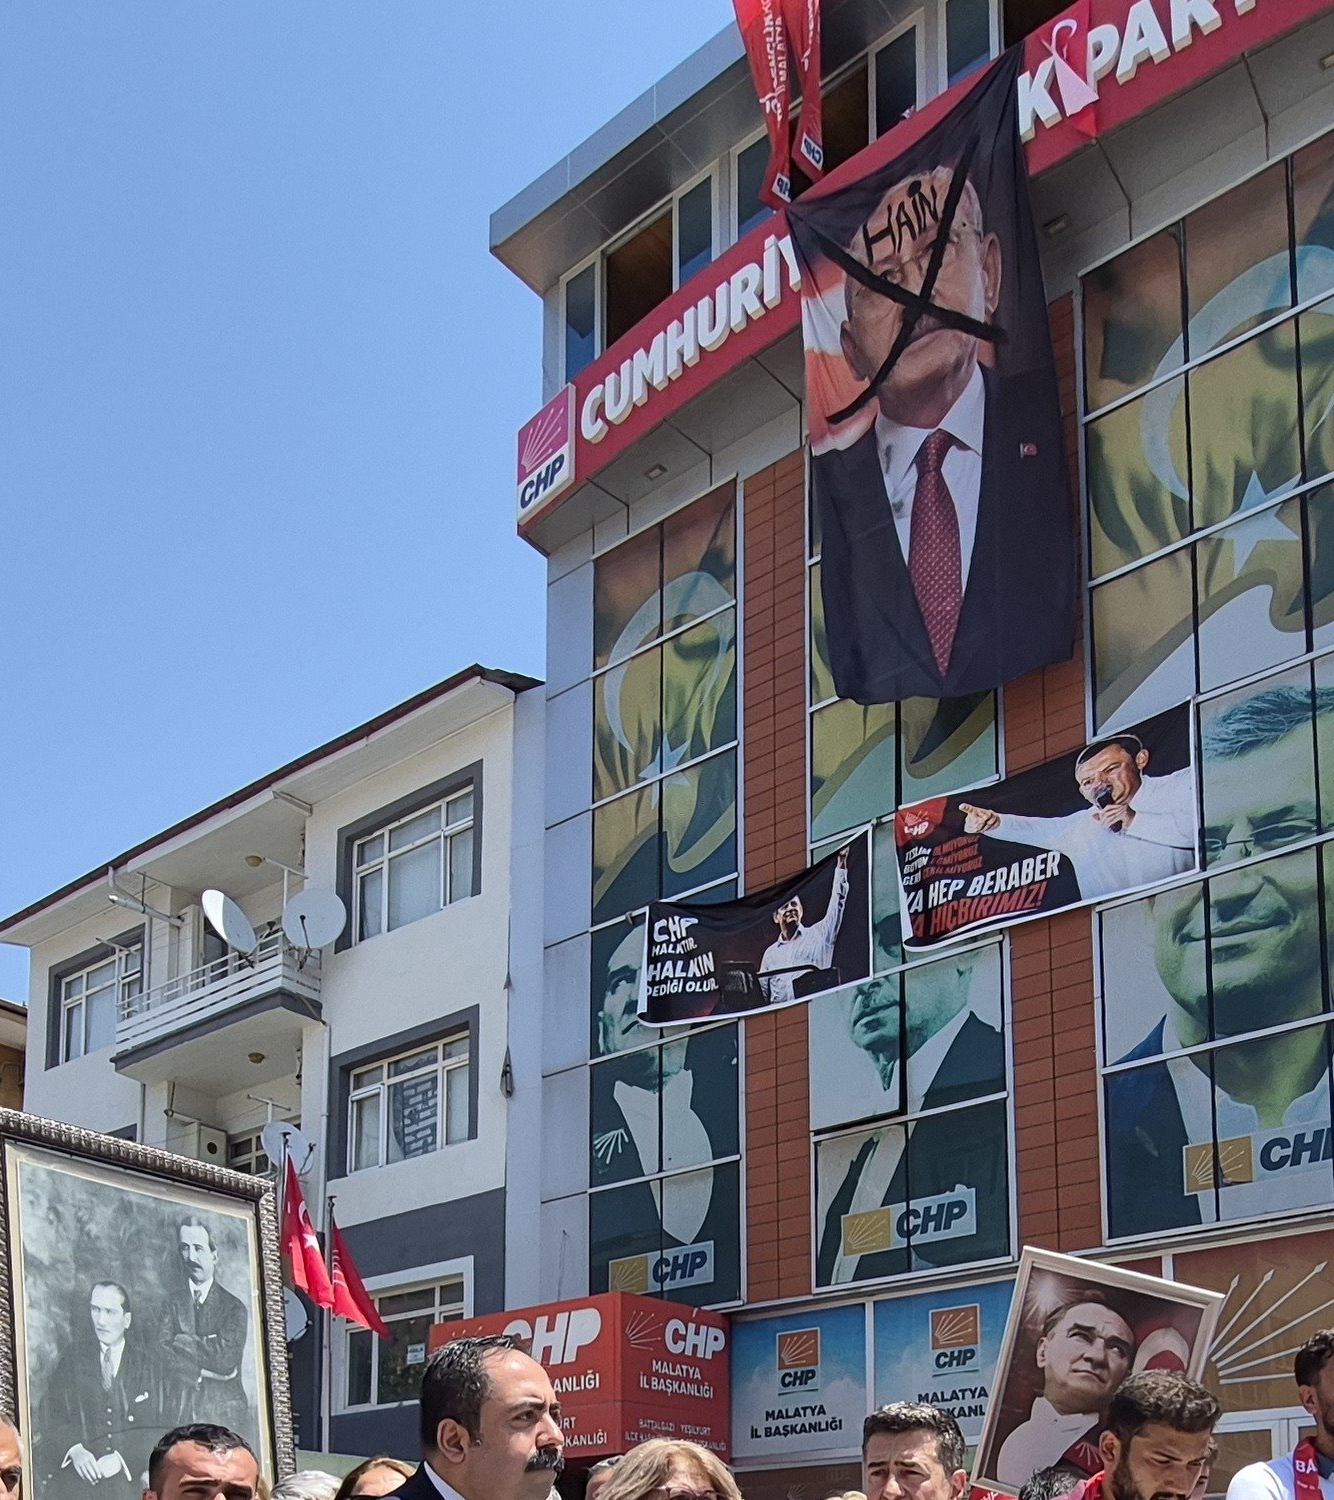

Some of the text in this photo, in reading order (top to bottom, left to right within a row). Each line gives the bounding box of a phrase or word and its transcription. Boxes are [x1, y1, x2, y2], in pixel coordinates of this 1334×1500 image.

[581, 234, 802, 444] CUMHURİY
[520, 453, 566, 510] CHP
[928, 878, 965, 909] HEP
[967, 850, 1061, 897] BERABER
[653, 915, 698, 942] CHP
[647, 951, 715, 981] HALKIN
[896, 1200, 968, 1238] CHP
[652, 1250, 707, 1284] CHP
[665, 1319, 726, 1360] CHP
[652, 1359, 701, 1381] MALATYA
[935, 1348, 976, 1369] CHP
[553, 1370, 599, 1393] ANLIĞI
[639, 1374, 714, 1399] İL BAŞKANLIĞI
[780, 1369, 817, 1388] CHP
[917, 1386, 989, 1403] MALATYA
[765, 1405, 827, 1421] MALATYA
[564, 1429, 607, 1447] KANLIĞI
[750, 1417, 843, 1439] İL BAŞKANLIĞI
